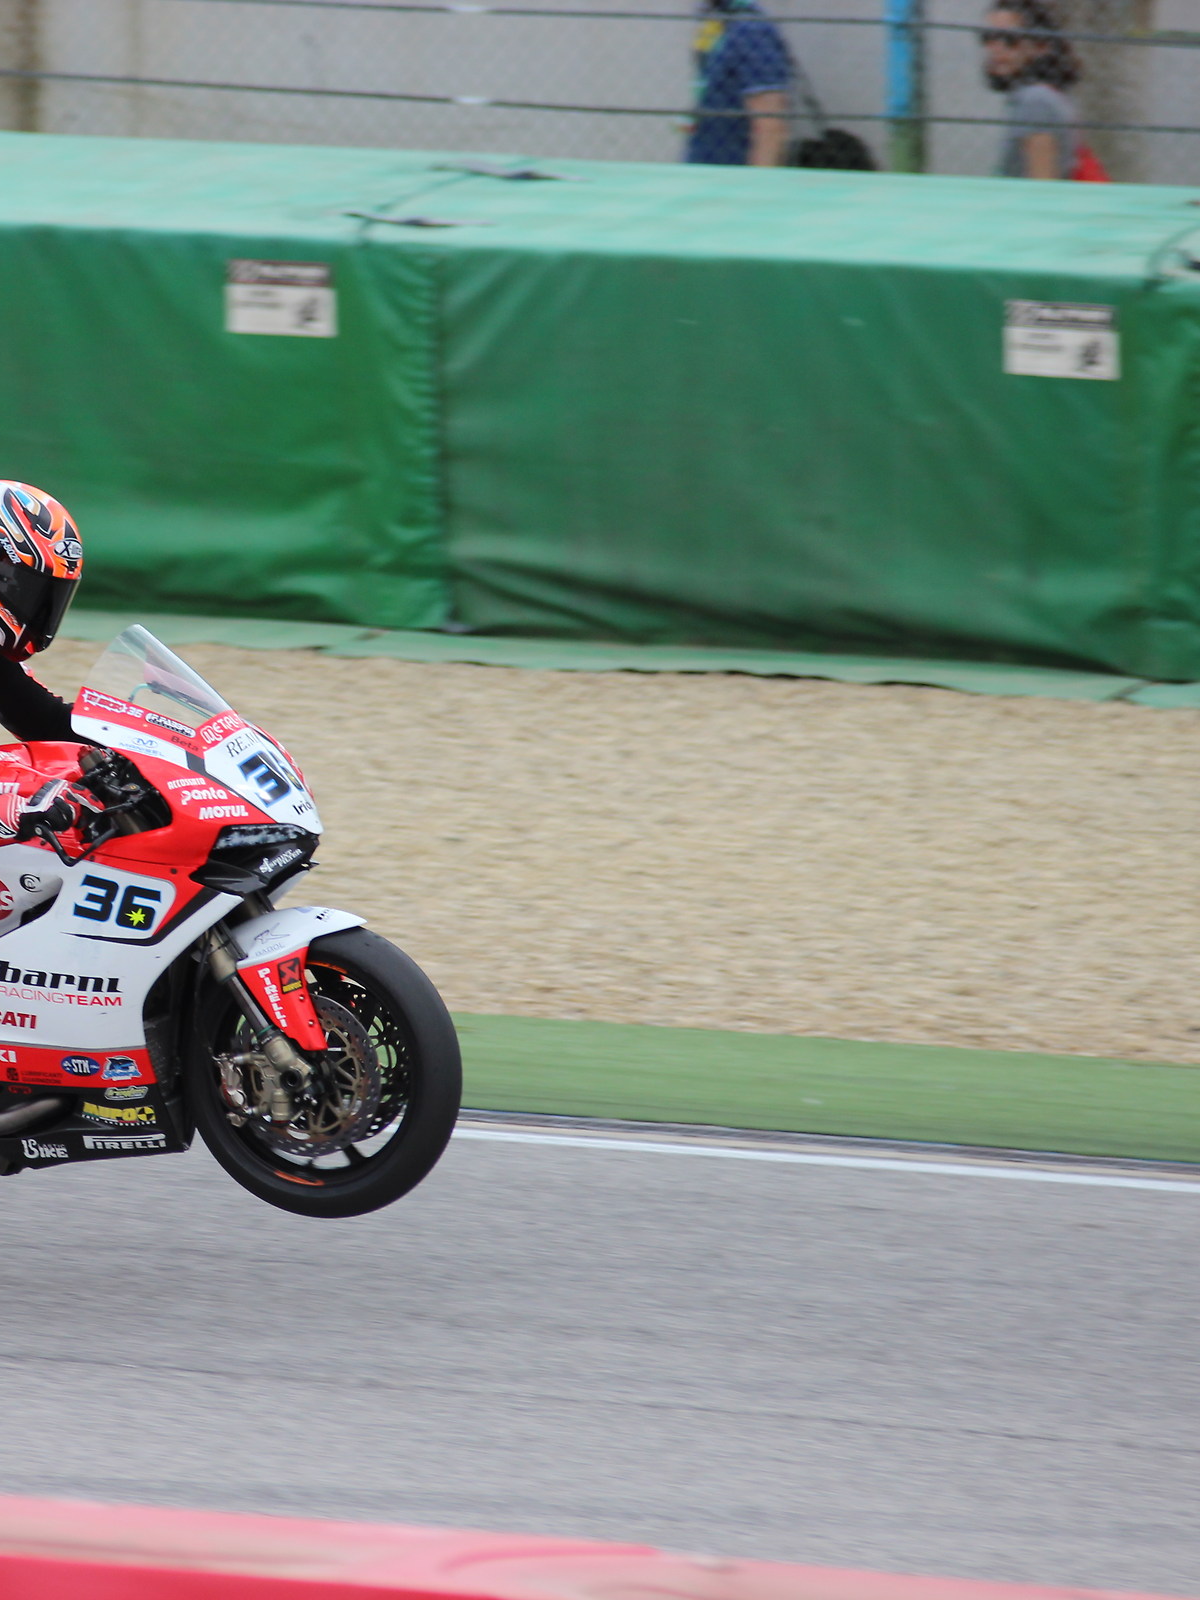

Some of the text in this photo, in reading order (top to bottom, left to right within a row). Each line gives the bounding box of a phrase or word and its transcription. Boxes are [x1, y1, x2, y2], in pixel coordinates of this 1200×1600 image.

[181, 787, 228, 806] panta
[199, 805, 248, 820] MOTUL
[73, 874, 161, 931] 36
[257, 967, 288, 1028] PIRELLI
[82, 1133, 166, 1150] PIRELLI
